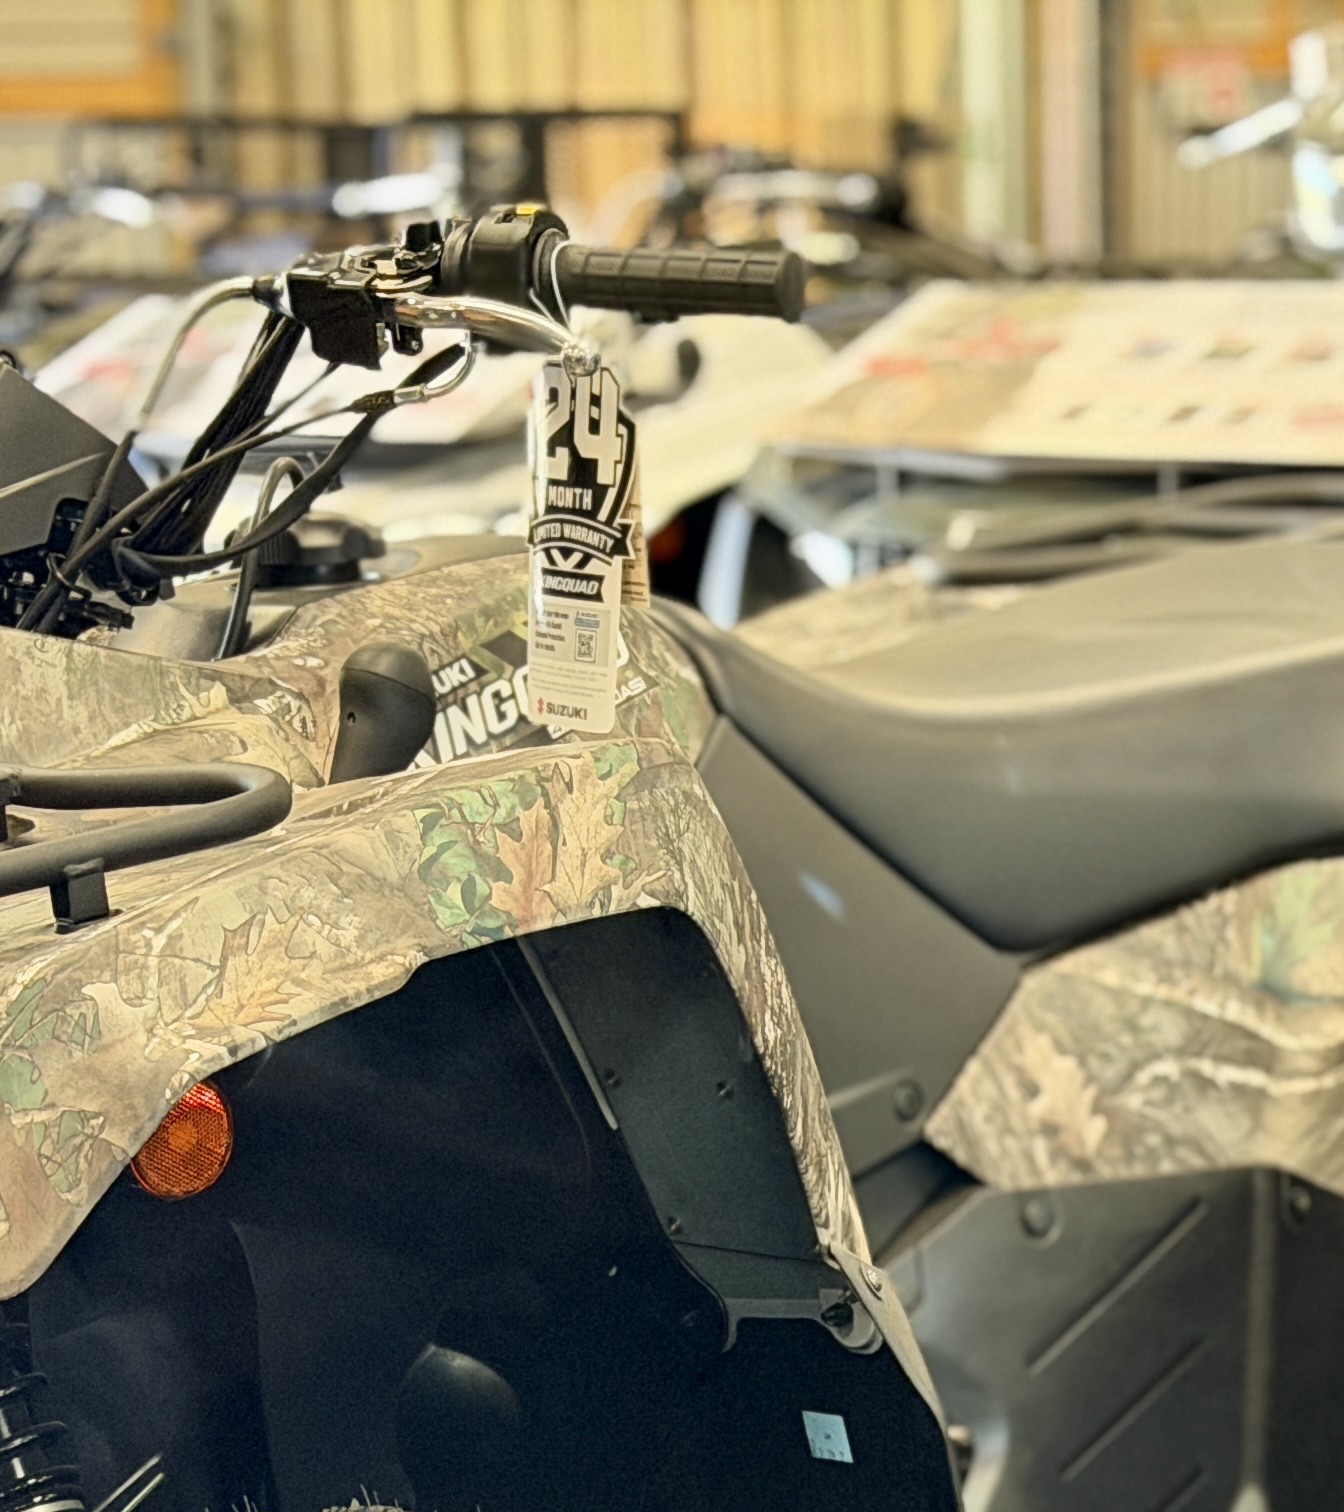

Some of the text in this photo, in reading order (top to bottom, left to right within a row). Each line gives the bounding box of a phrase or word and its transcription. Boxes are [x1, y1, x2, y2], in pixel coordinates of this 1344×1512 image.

[542, 362, 623, 485] 24
[548, 486, 593, 510] MONTH
[533, 523, 614, 553] LIMITED WARRANTY
[546, 702, 588, 720] SUZUKI
